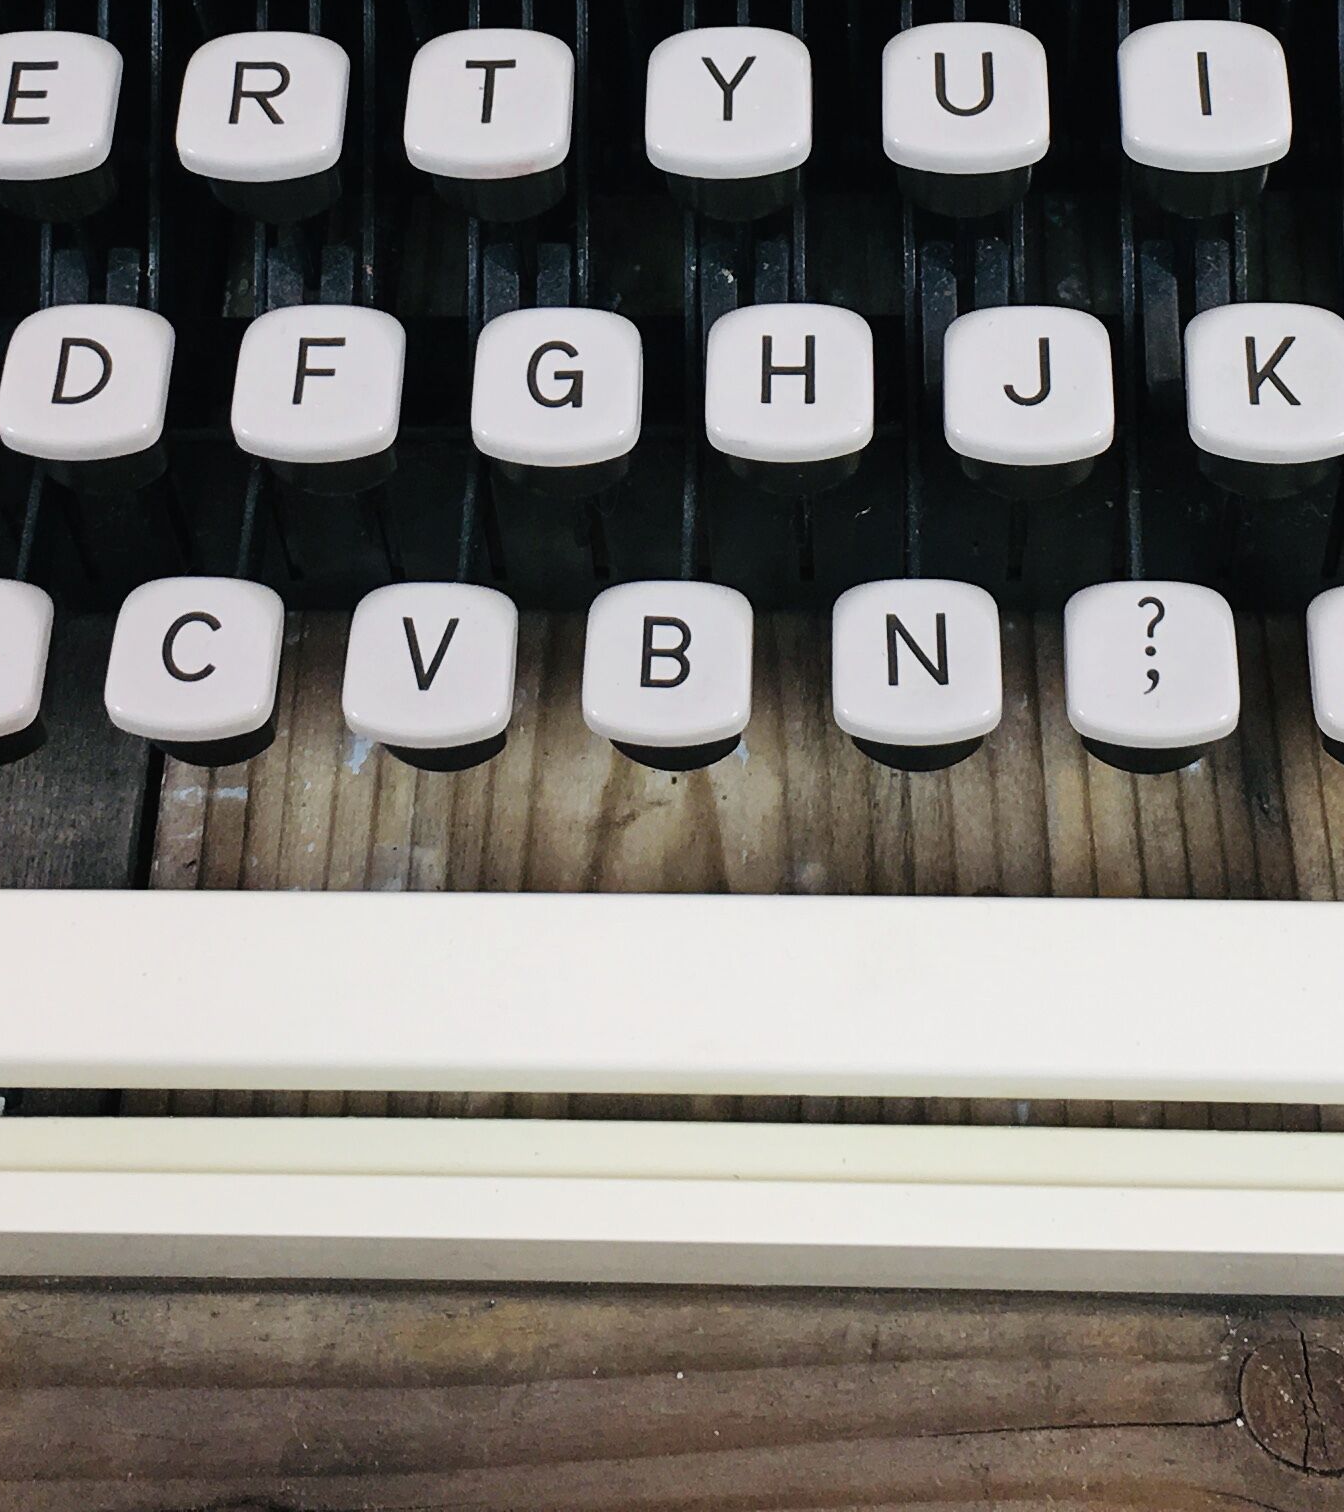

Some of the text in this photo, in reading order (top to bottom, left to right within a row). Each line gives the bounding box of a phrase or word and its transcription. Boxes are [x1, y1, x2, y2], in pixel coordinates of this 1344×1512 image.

[0, 59, 60, 127] E
[227, 60, 292, 126] R
[464, 57, 518, 125] T
[700, 54, 758, 123] Y
[933, 50, 996, 118] U
[1195, 50, 1214, 117] I
[49, 336, 114, 406] D
[290, 336, 347, 407] F
[525, 339, 585, 410] G
[759, 333, 817, 406] H
[1002, 336, 1053, 408] J
[1243, 334, 1303, 407] K
[160, 610, 223, 684] C
[401, 615, 461, 693] V
[638, 614, 693, 690] B
[884, 611, 951, 688] N
[1136, 595, 1167, 658] ?
